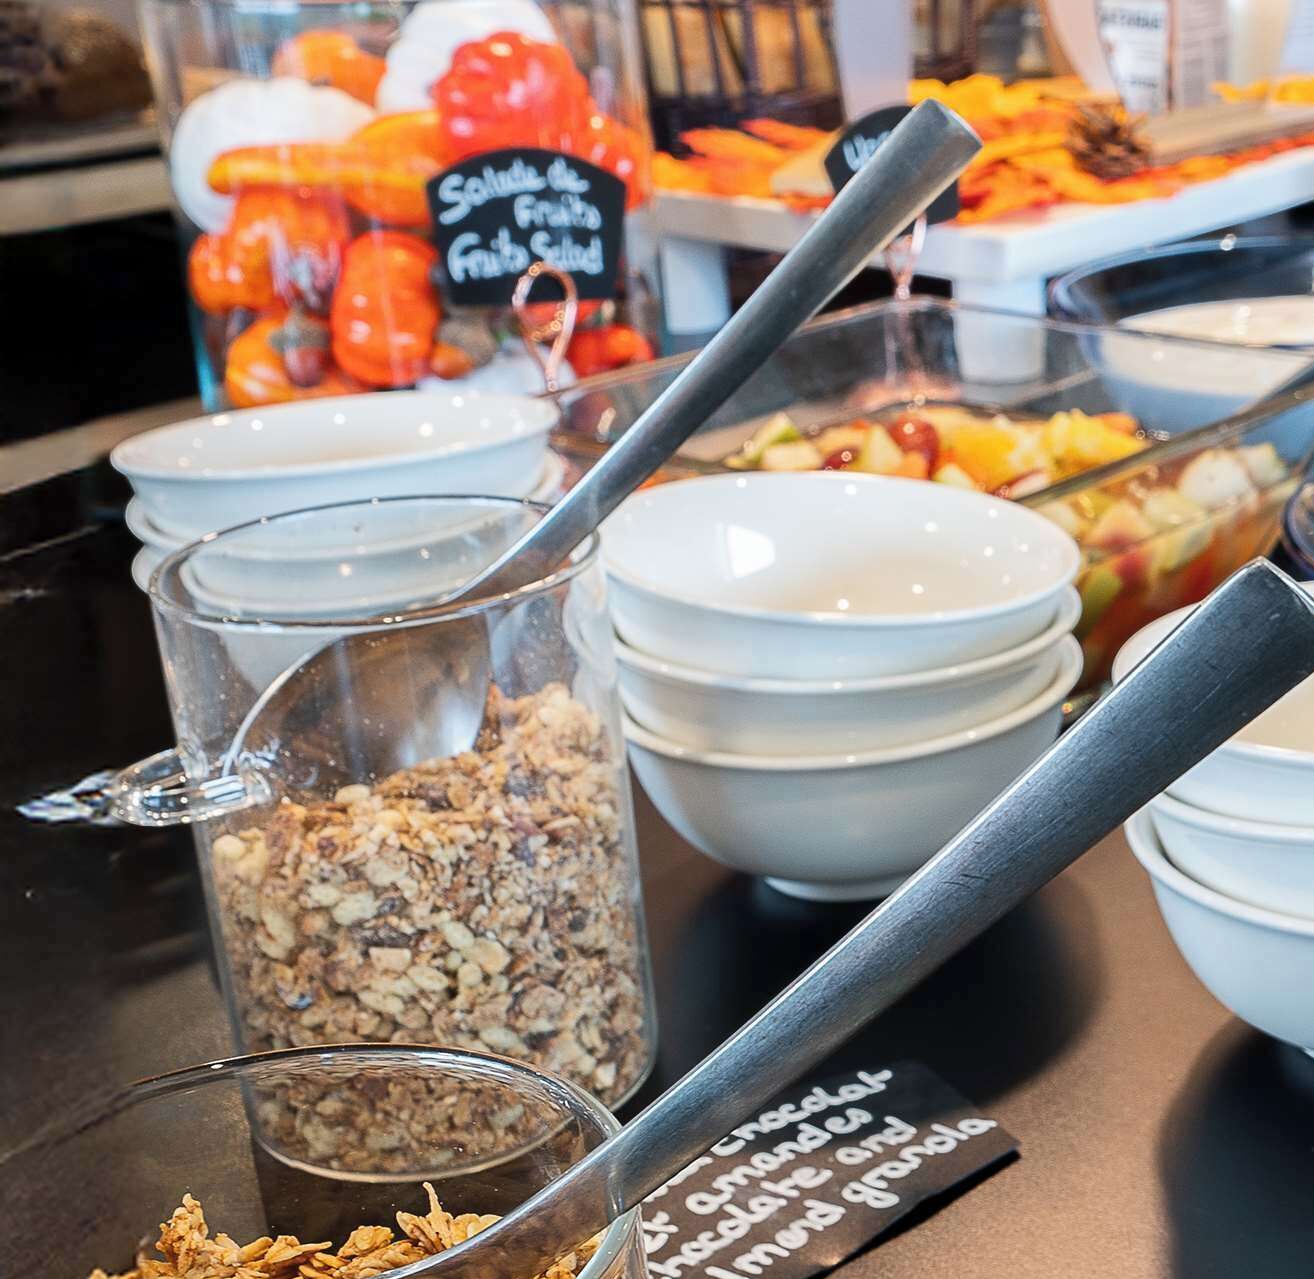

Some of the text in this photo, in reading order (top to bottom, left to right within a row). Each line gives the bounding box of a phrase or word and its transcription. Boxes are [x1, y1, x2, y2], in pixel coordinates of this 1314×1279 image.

[438, 157, 547, 225] Salade
[685, 1108, 873, 1215] amandes
[834, 1116, 918, 1166] and
[841, 1117, 998, 1209] granola
